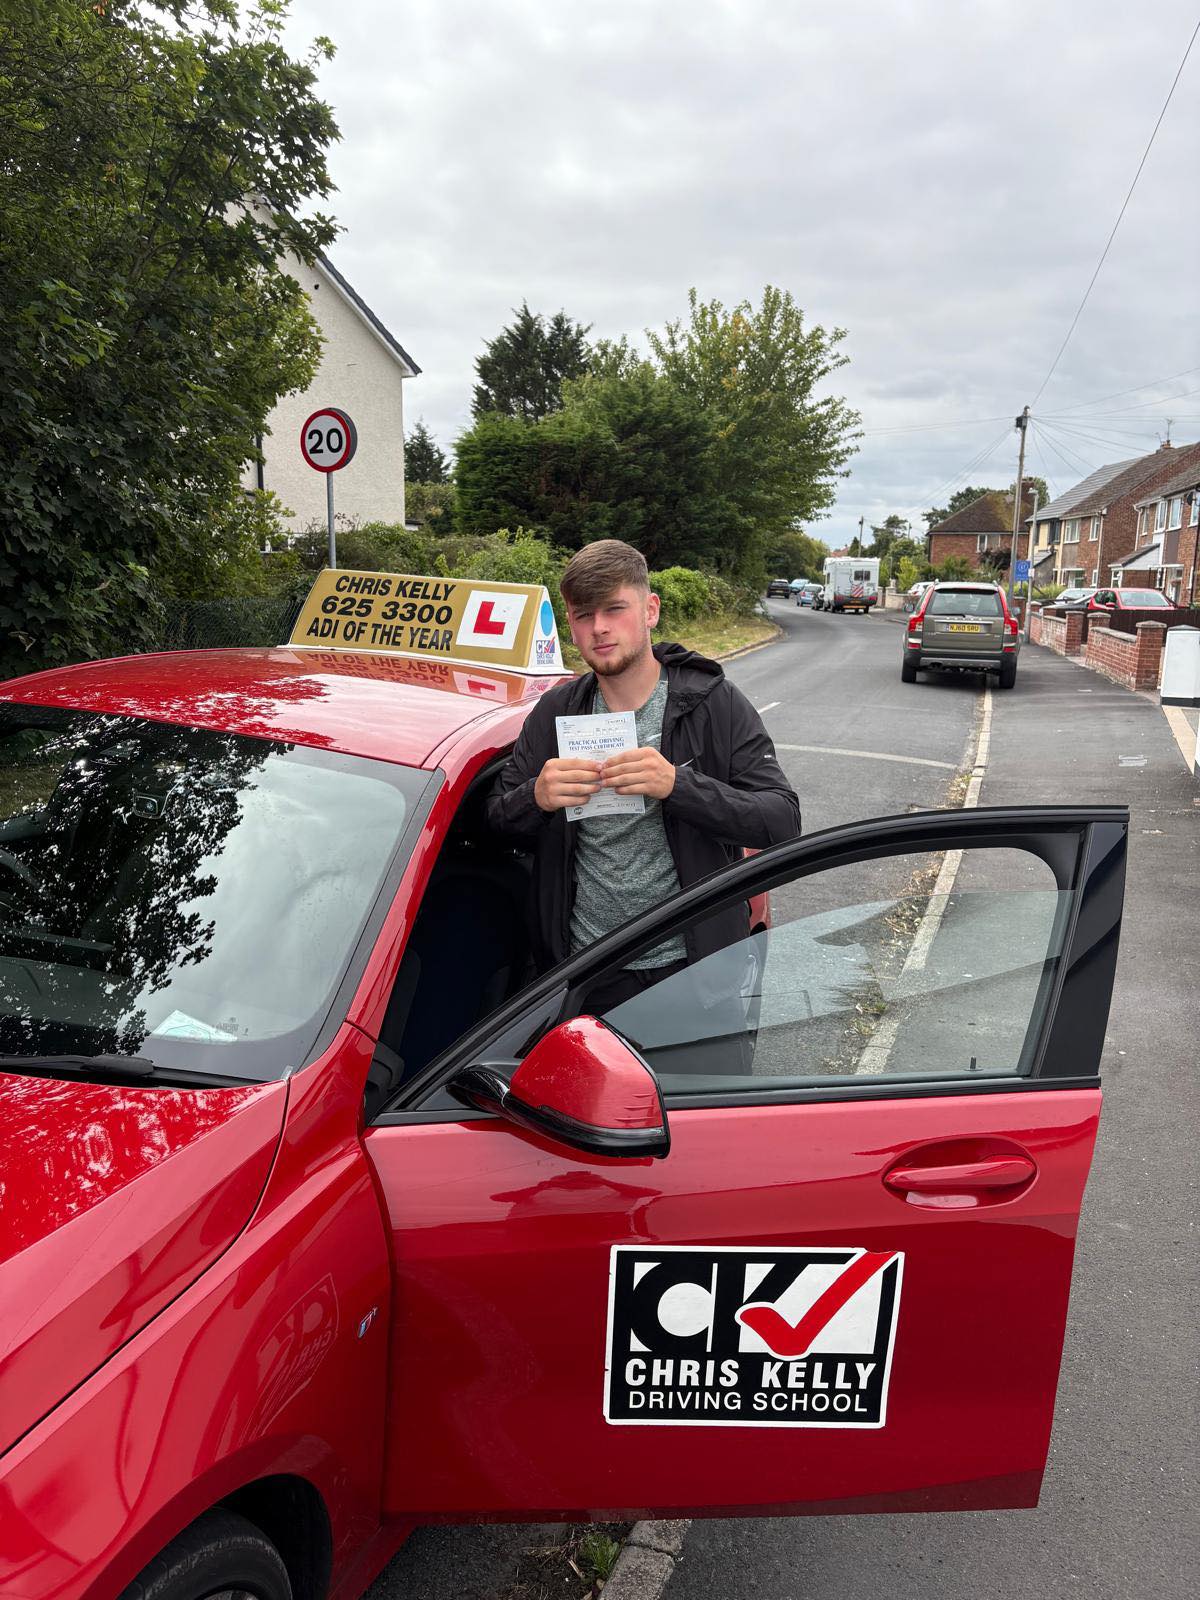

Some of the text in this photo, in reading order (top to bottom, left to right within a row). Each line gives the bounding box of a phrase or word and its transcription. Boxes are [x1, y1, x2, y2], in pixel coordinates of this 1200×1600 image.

[308, 428, 343, 454] 20
[335, 575, 456, 601] CHRIS KELLY
[321, 596, 453, 625] 625 3300
[473, 601, 506, 635] L
[306, 617, 453, 651] ADI OF THE YEAR
[624, 1357, 876, 1389] CHRIS KELLY
[629, 1391, 867, 1412] DRIVING SCHOOL
